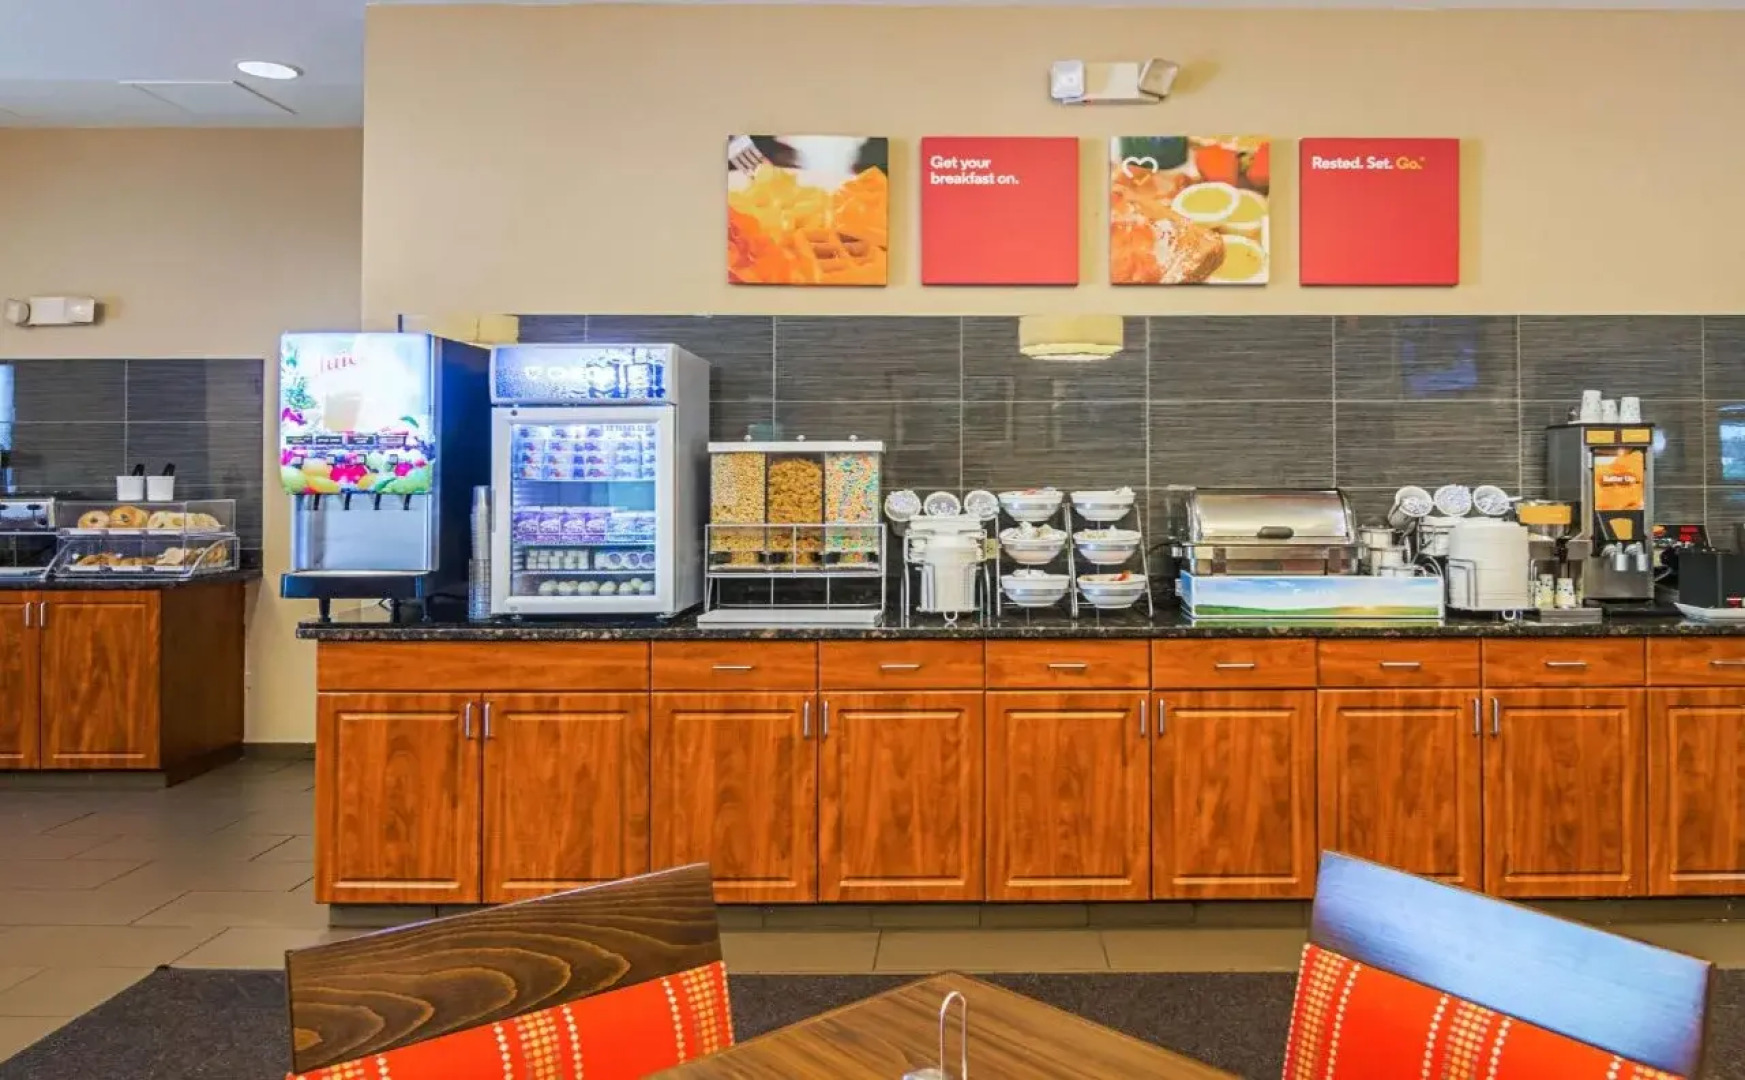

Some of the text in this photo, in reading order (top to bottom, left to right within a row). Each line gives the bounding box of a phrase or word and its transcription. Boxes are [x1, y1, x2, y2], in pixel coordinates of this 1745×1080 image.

[930, 155, 992, 171] Get your
[1312, 155, 1364, 170] Rested.
[1366, 156, 1394, 170] Set.
[930, 171, 1020, 185] breakfast on.
